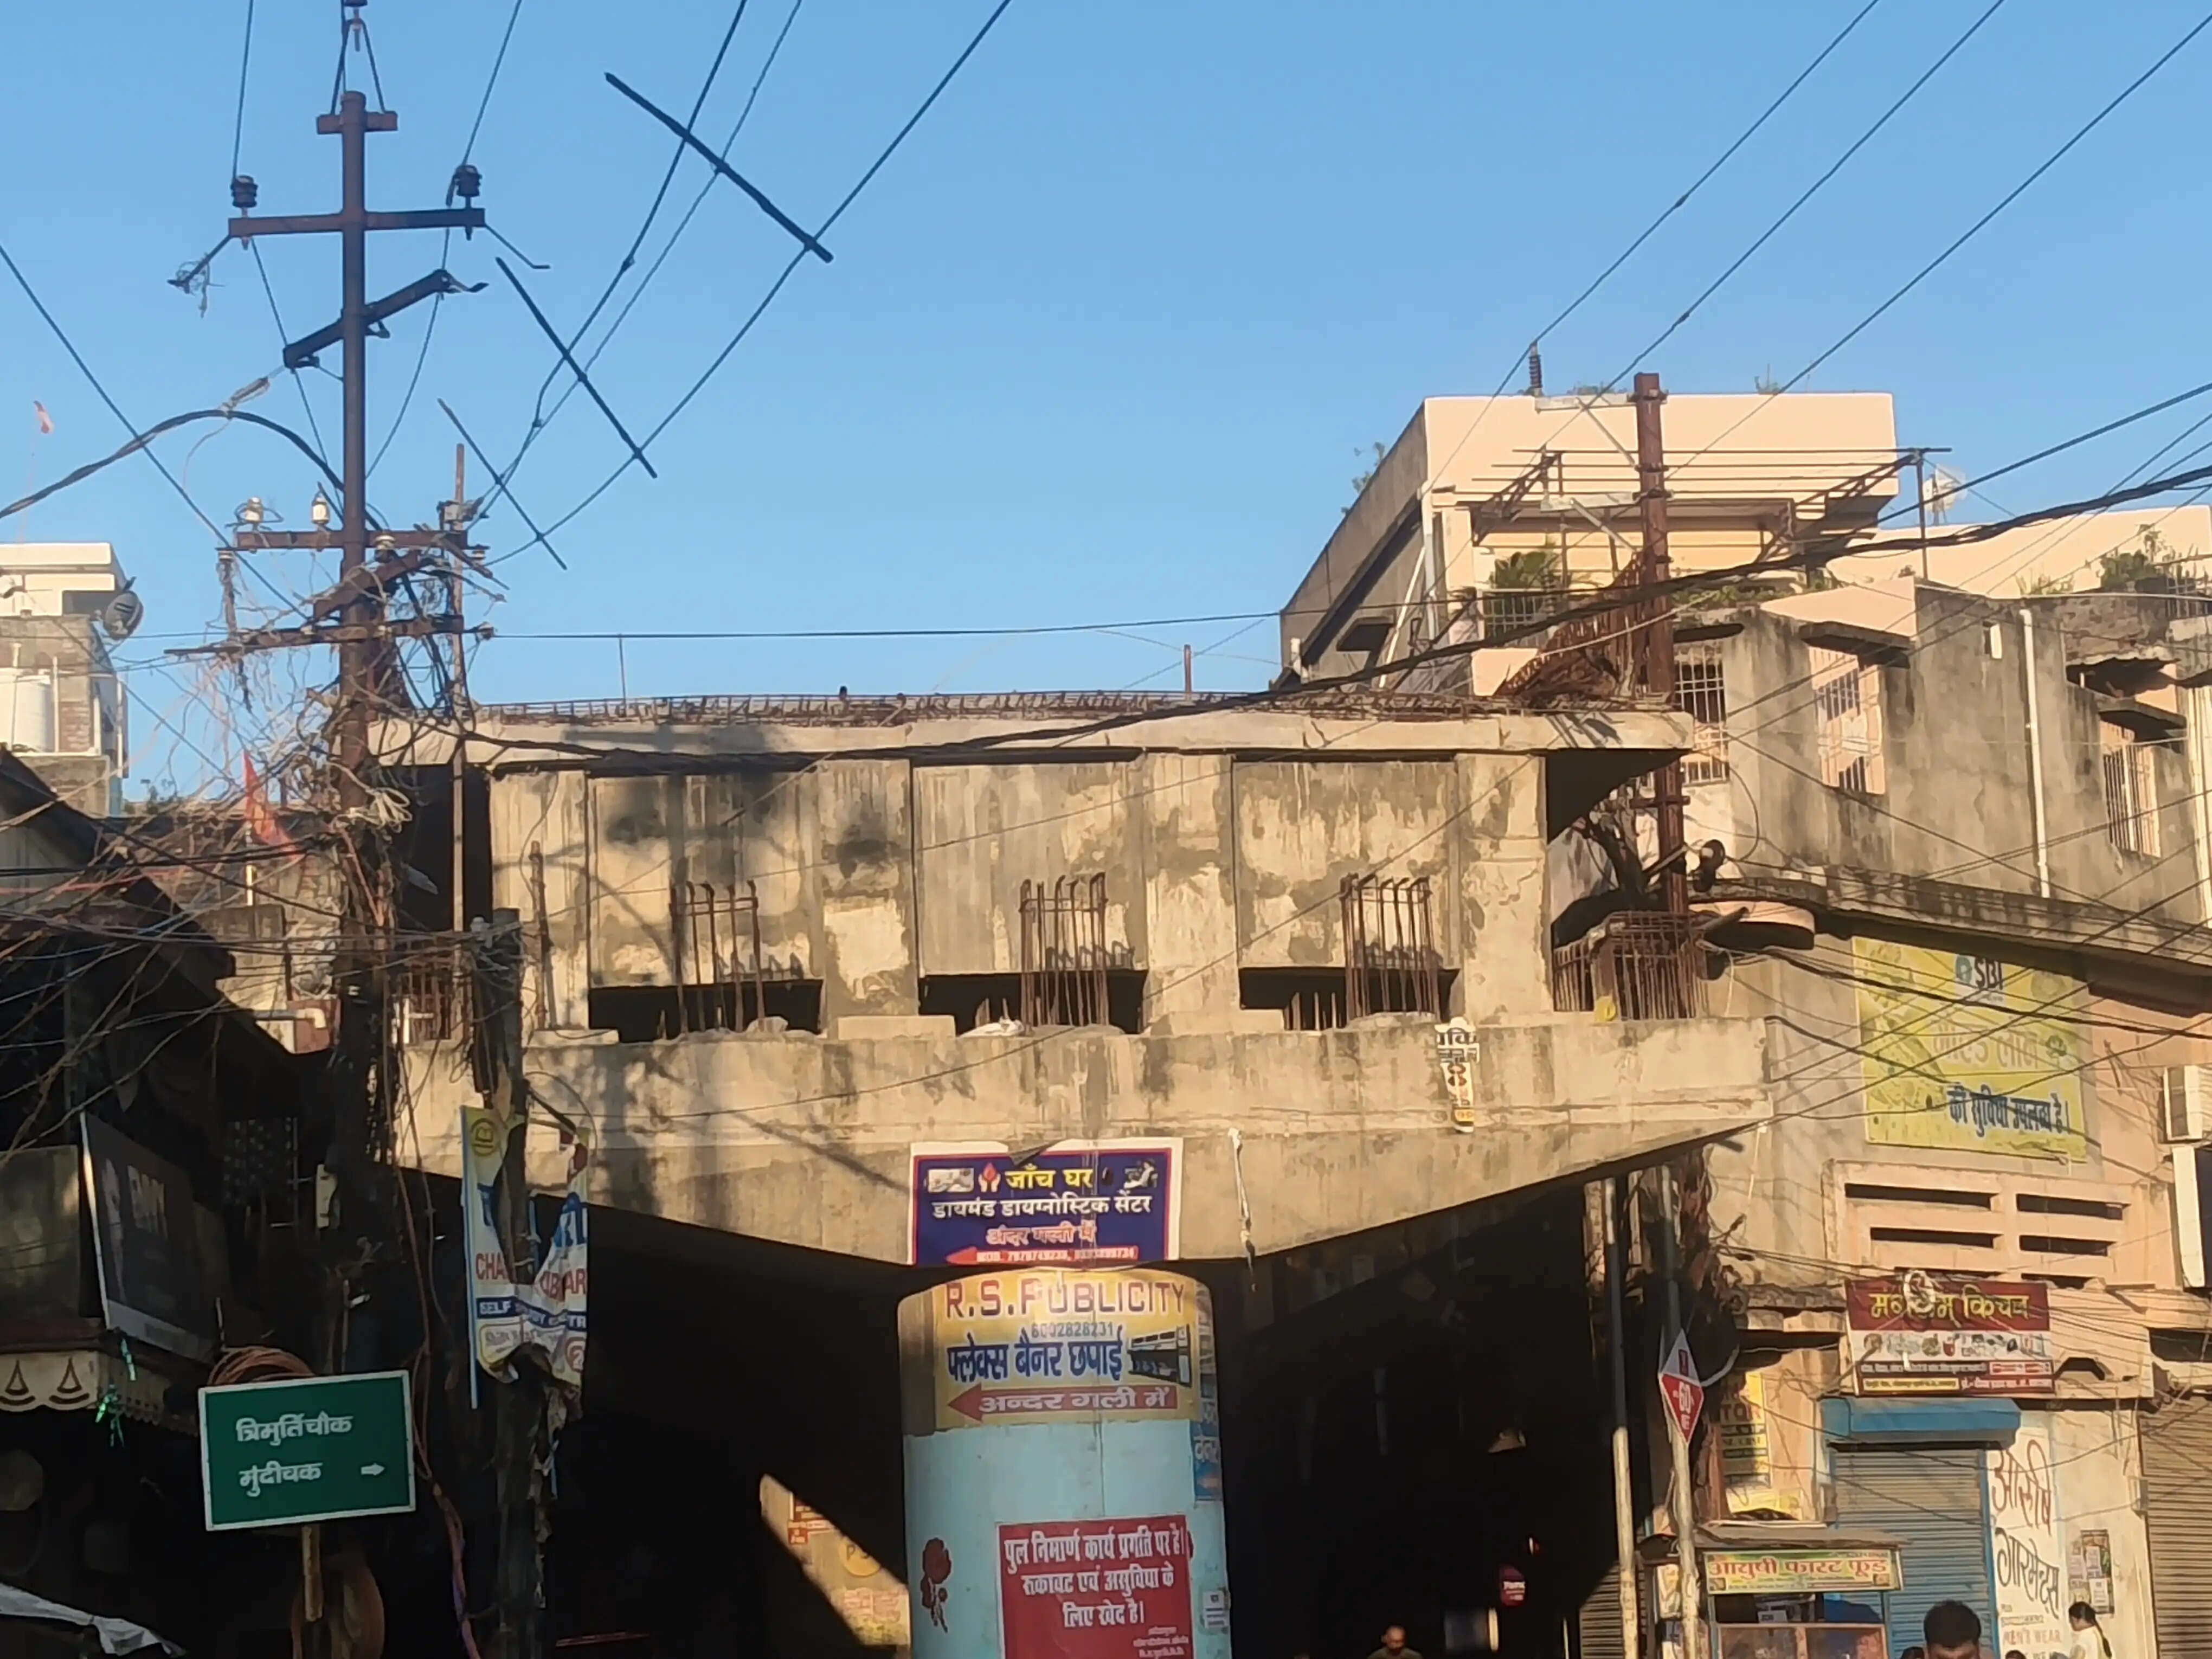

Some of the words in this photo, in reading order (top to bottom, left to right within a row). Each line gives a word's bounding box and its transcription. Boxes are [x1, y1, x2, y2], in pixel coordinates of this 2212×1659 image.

[1975, 956, 2003, 990] SBI
[1005, 1164, 1056, 1188] जाँच
[1063, 1168, 1094, 1188] घर
[933, 1195, 995, 1218] डायमंड
[1115, 1189, 1152, 1214] सेंटर
[480, 1301, 511, 1315] SELF
[1962, 1284, 2029, 1319] किचन
[1014, 1328, 1063, 1377] बैनर
[1068, 1326, 1123, 1381] छपाई
[979, 1393, 1063, 1414] अन्दर
[1069, 1387, 1136, 1410] गली
[1144, 1388, 1169, 1409] में
[1004, 1539, 1029, 1574] पुल
[1083, 1526, 1115, 1560] कार्य
[1118, 1525, 1153, 1560] प्रगति
[1155, 1531, 1171, 1556] पर
[1077, 1565, 1099, 1592] एवं
[1104, 1563, 1159, 1597] असुविधा
[1161, 1561, 1174, 1586] के
[1709, 1558, 1777, 1579] आयुषी
[1785, 1559, 1843, 1575] फास्ट
[1849, 1559, 1887, 1577] फूड
[1063, 1602, 1094, 1627] लिए
[1095, 1599, 1125, 1625] खेद
